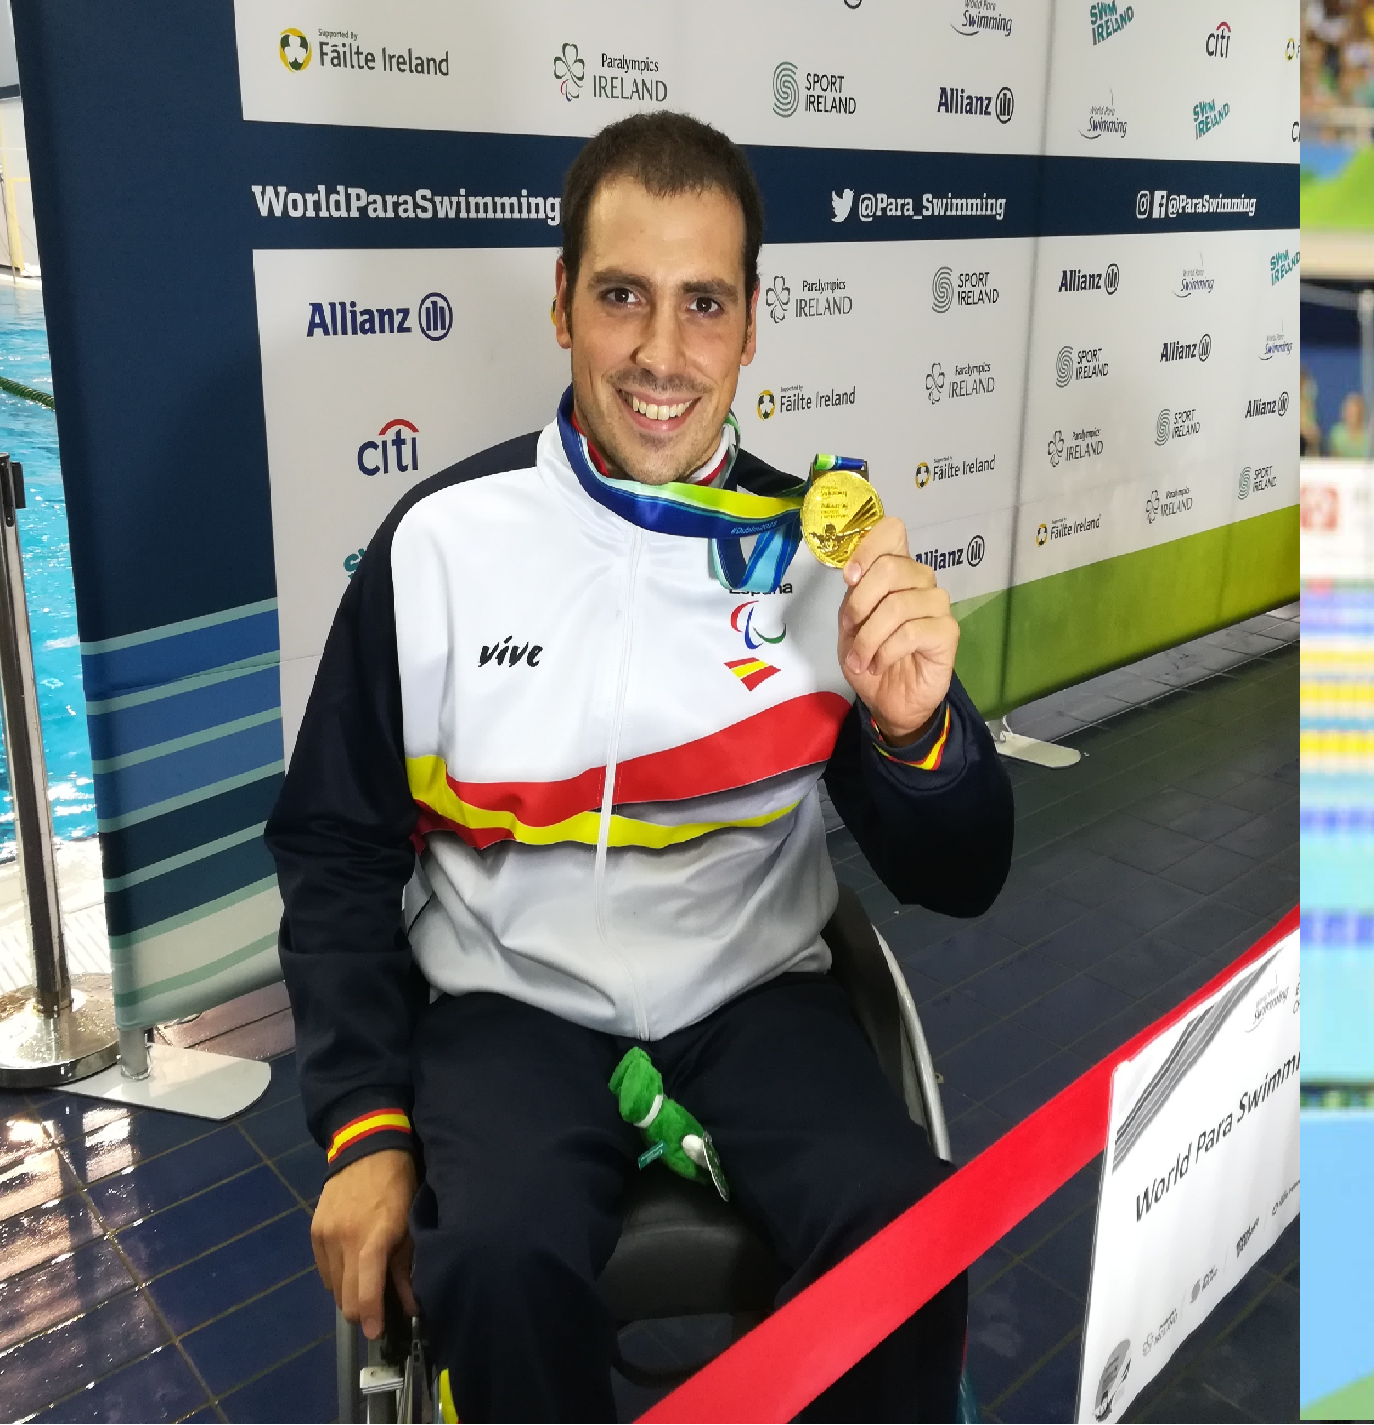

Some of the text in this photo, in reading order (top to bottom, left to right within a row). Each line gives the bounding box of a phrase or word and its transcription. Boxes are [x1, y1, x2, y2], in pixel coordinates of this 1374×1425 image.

[961, 9, 1012, 37] Swimming
[1090, 0, 1118, 26] SWIM
[1090, 4, 1134, 45] IRELAND
[382, 47, 449, 76] Ireland
[602, 53, 658, 74] Paralympics
[594, 73, 667, 102] IRELAND
[805, 73, 844, 96] SPORT
[805, 94, 856, 114] IRELAND
[937, 87, 991, 115] Allianz
[1193, 99, 1217, 123] SWIM
[1085, 114, 1127, 139] Swimming
[1193, 101, 1230, 140] IRELAND
[252, 185, 561, 226] WorldParaSwimming
[859, 193, 1006, 221] @Para_Swimming
[1165, 191, 1256, 217] @ParaSwimming
[1271, 249, 1292, 273] SWIM
[803, 278, 845, 294] Paralympics
[958, 272, 991, 290] SPORT
[1058, 269, 1102, 292] Allianz
[1181, 275, 1214, 295] Swimming
[796, 296, 852, 317] IRELAND
[958, 287, 999, 305] IRELAND
[307, 301, 412, 337] Allianz
[1078, 348, 1103, 364] SPORT
[1160, 341, 1197, 362] Allianz
[955, 362, 991, 378] Paralympics
[1076, 360, 1108, 380] IRELAND
[816, 386, 855, 408] Ireland
[949, 377, 994, 398] IRELAND
[1174, 409, 1198, 423] SPORT
[1245, 399, 1276, 418] Allianz
[1172, 419, 1200, 438] IRELAND
[358, 427, 419, 476] citi
[1065, 440, 1104, 462] IRELAND
[963, 454, 995, 475] Ireland
[1254, 466, 1274, 480] SPORT
[1253, 474, 1276, 492] IRELAND
[1161, 496, 1192, 516] IRELAND
[1074, 514, 1101, 533] Ireland
[478, 636, 543, 667] vive
[1136, 1141, 1192, 1222] World
[1196, 1112, 1233, 1164] Para
